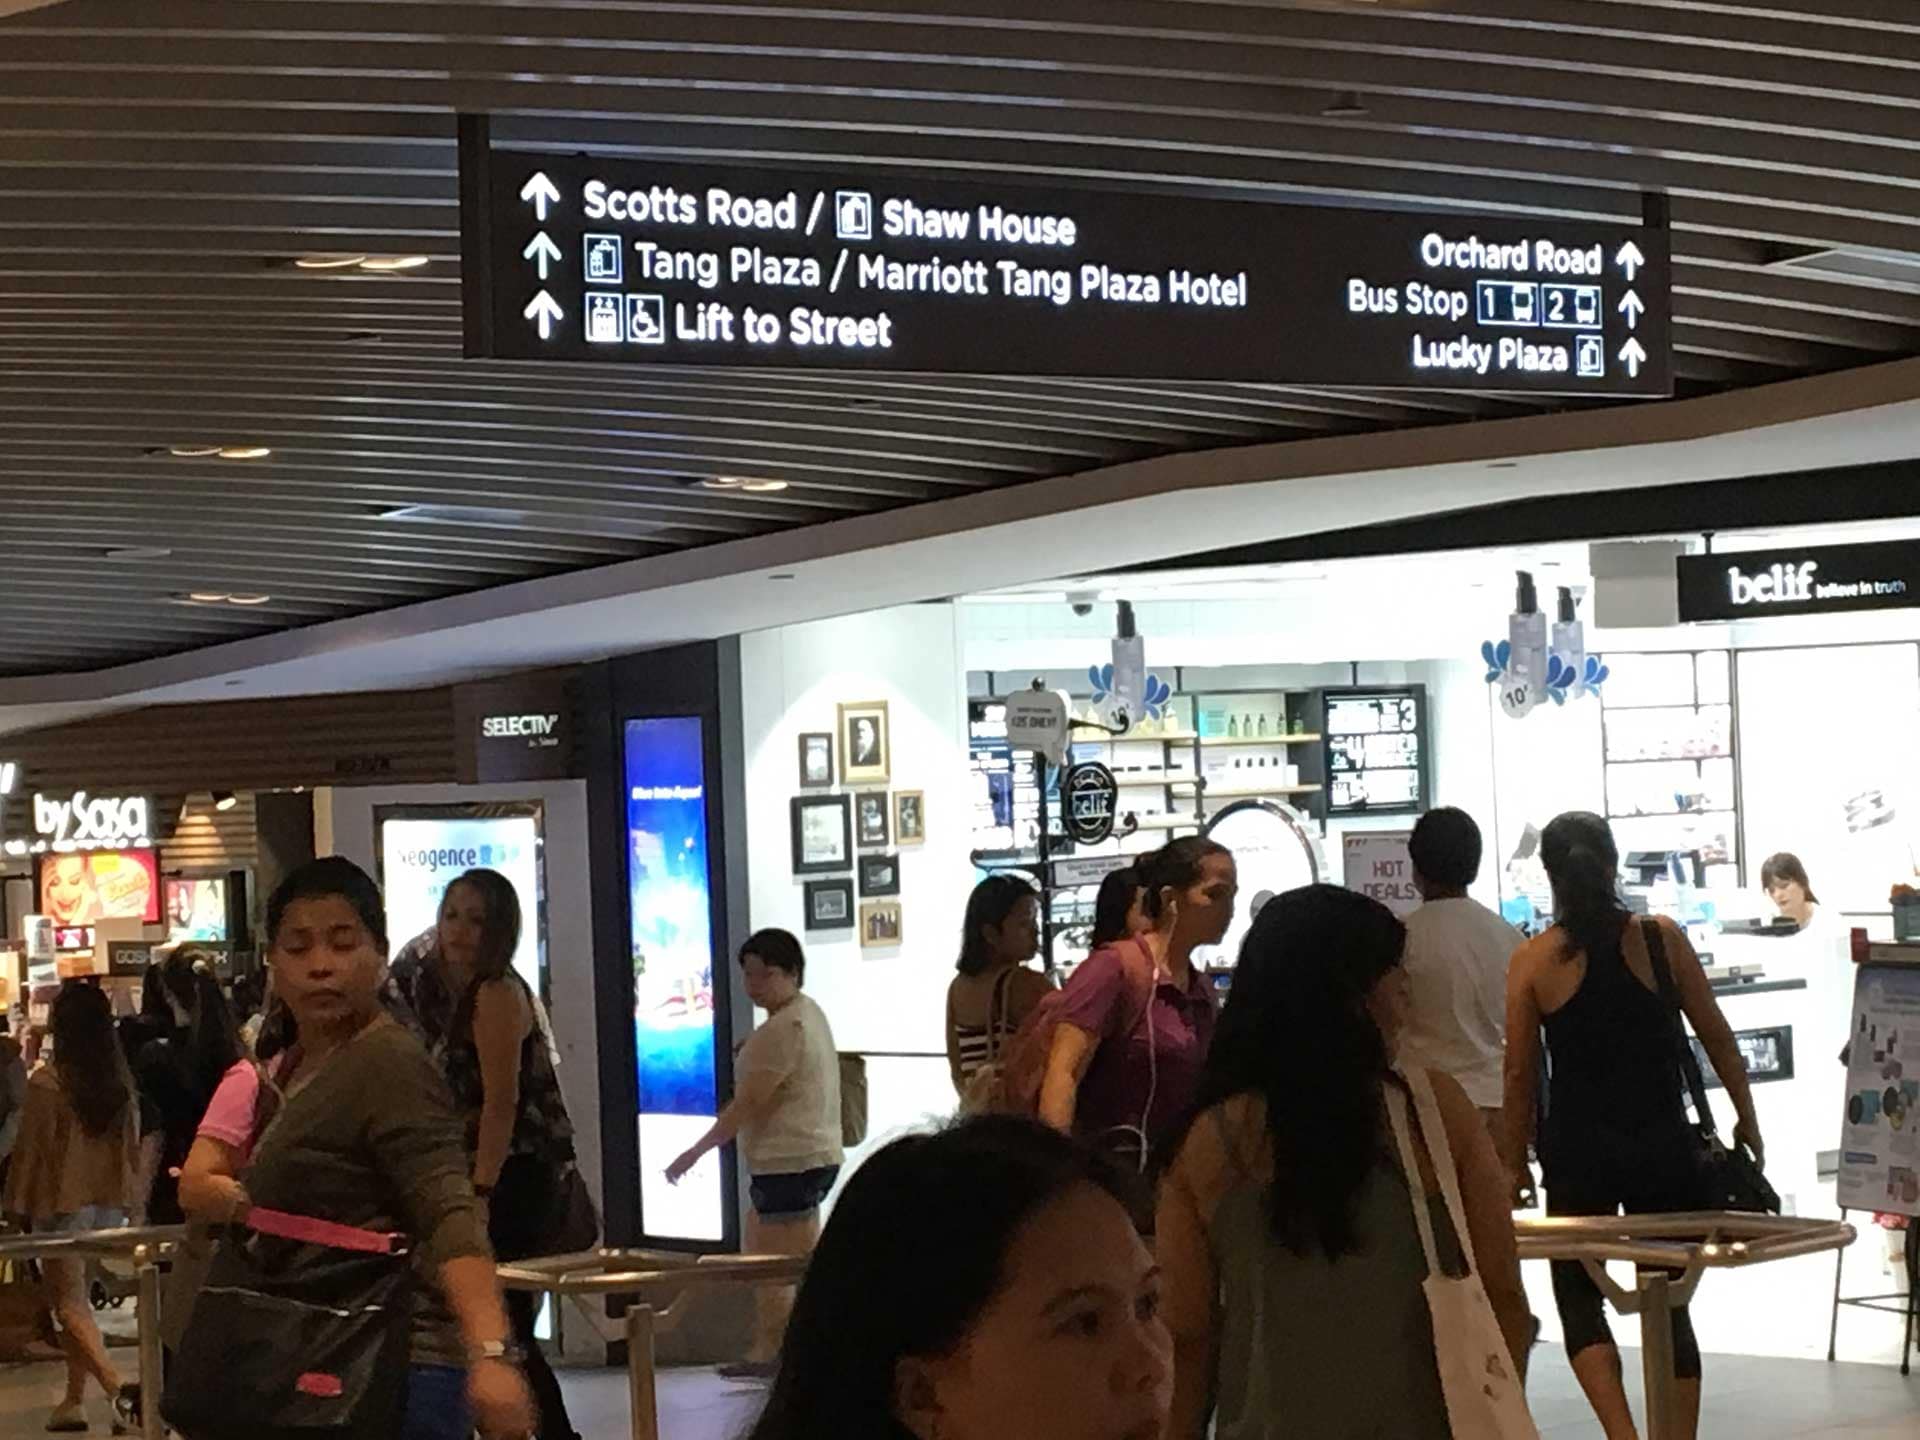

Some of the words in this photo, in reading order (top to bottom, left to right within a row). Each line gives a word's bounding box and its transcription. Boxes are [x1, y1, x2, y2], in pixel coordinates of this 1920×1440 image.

[583, 180, 697, 225] Scotts
[707, 188, 797, 230] Road
[805, 191, 825, 236] /
[882, 198, 971, 240] Shaw
[979, 205, 1077, 247] House
[634, 241, 719, 289] Tang
[730, 246, 821, 287] Plaza
[829, 248, 849, 293] /
[858, 253, 989, 295] Marriott
[995, 260, 1072, 306] Tang
[1080, 264, 1161, 303] Plaza
[1169, 269, 1247, 307] Hotel
[1420, 232, 1529, 272] Orchard
[1534, 239, 1603, 276] Road
[1348, 278, 1399, 314] Bus
[1405, 280, 1469, 322] Stop
[1483, 287, 1495, 318] 1
[1548, 290, 1565, 321] 2
[675, 302, 735, 342] Lift
[742, 306, 781, 345] to
[789, 306, 893, 348] Street
[1412, 333, 1493, 375] Lucky
[1498, 337, 1569, 372] Plaza
[1728, 560, 1818, 605] belif
[1860, 580, 1873, 596] in
[1874, 579, 1907, 595] truth
[33, 792, 71, 841] by
[72, 790, 149, 840] Sasa
[1373, 859, 1405, 878] HOT
[1363, 881, 1417, 901] DEALS
